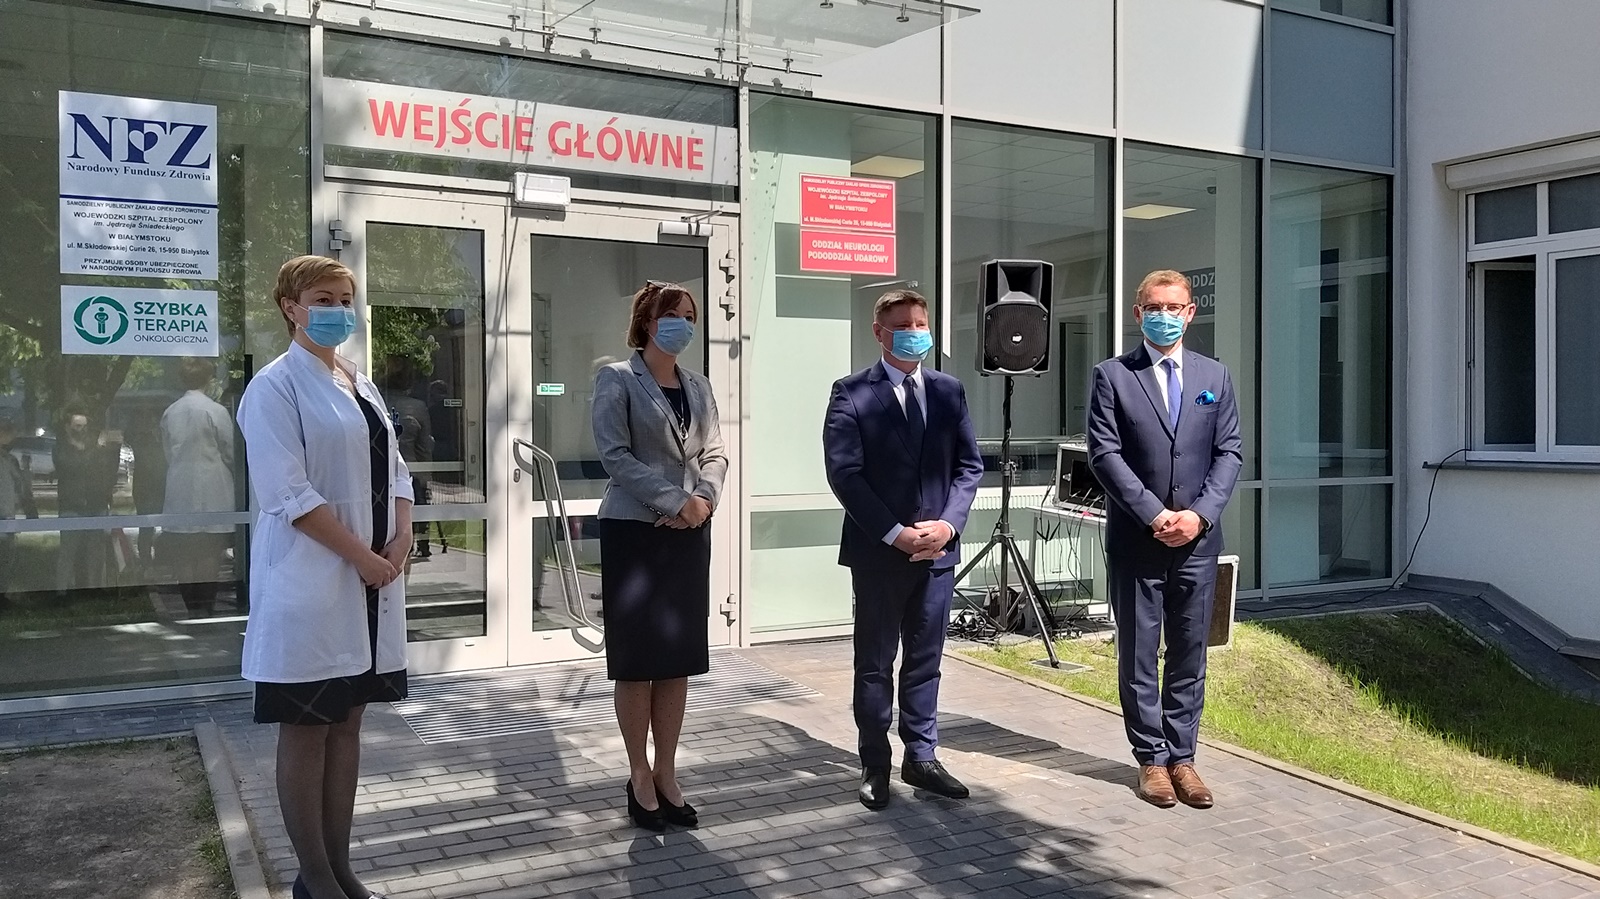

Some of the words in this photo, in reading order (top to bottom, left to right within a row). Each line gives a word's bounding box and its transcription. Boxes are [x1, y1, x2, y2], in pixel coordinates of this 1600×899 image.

[67, 112, 212, 170] NFZ
[368, 98, 534, 152] WEJŚCIE
[548, 116, 704, 171] GŁÓWNE
[67, 161, 121, 176] Narodowy
[123, 166, 167, 178] Fundusz
[169, 169, 211, 181] Zdrowia
[66, 200, 104, 208] SAMODZIELNY
[105, 202, 134, 210] PUBLICZNY
[73, 211, 126, 220] WOJEWÓDZKI
[128, 214, 157, 223] SZPITAL
[159, 216, 204, 225] ZESPOLONY
[106, 220, 136, 230] Jędrzeja
[138, 221, 185, 232] Śniadeckiego
[118, 233, 171, 243] BIAŁYMSTOKU
[159, 246, 180, 254] 15-950
[181, 247, 210, 256] Białystok
[811, 239, 843, 250] ODDZIAŁ
[844, 241, 885, 252] NEUROLOGII
[84, 257, 124, 266] PRZYJMUJE
[125, 259, 149, 267] OSOBY
[150, 261, 199, 269] UBEZPIECZONE
[808, 250, 853, 262] PODODDZIAŁ
[854, 253, 889, 264] UDAROWY
[89, 264, 134, 272] NARODOWYM
[135, 266, 171, 274] FUNDUSZU
[134, 301, 208, 317] SZYBKA
[134, 318, 208, 333] TERAPIA
[134, 334, 209, 344] ONKOLOGICZNA
